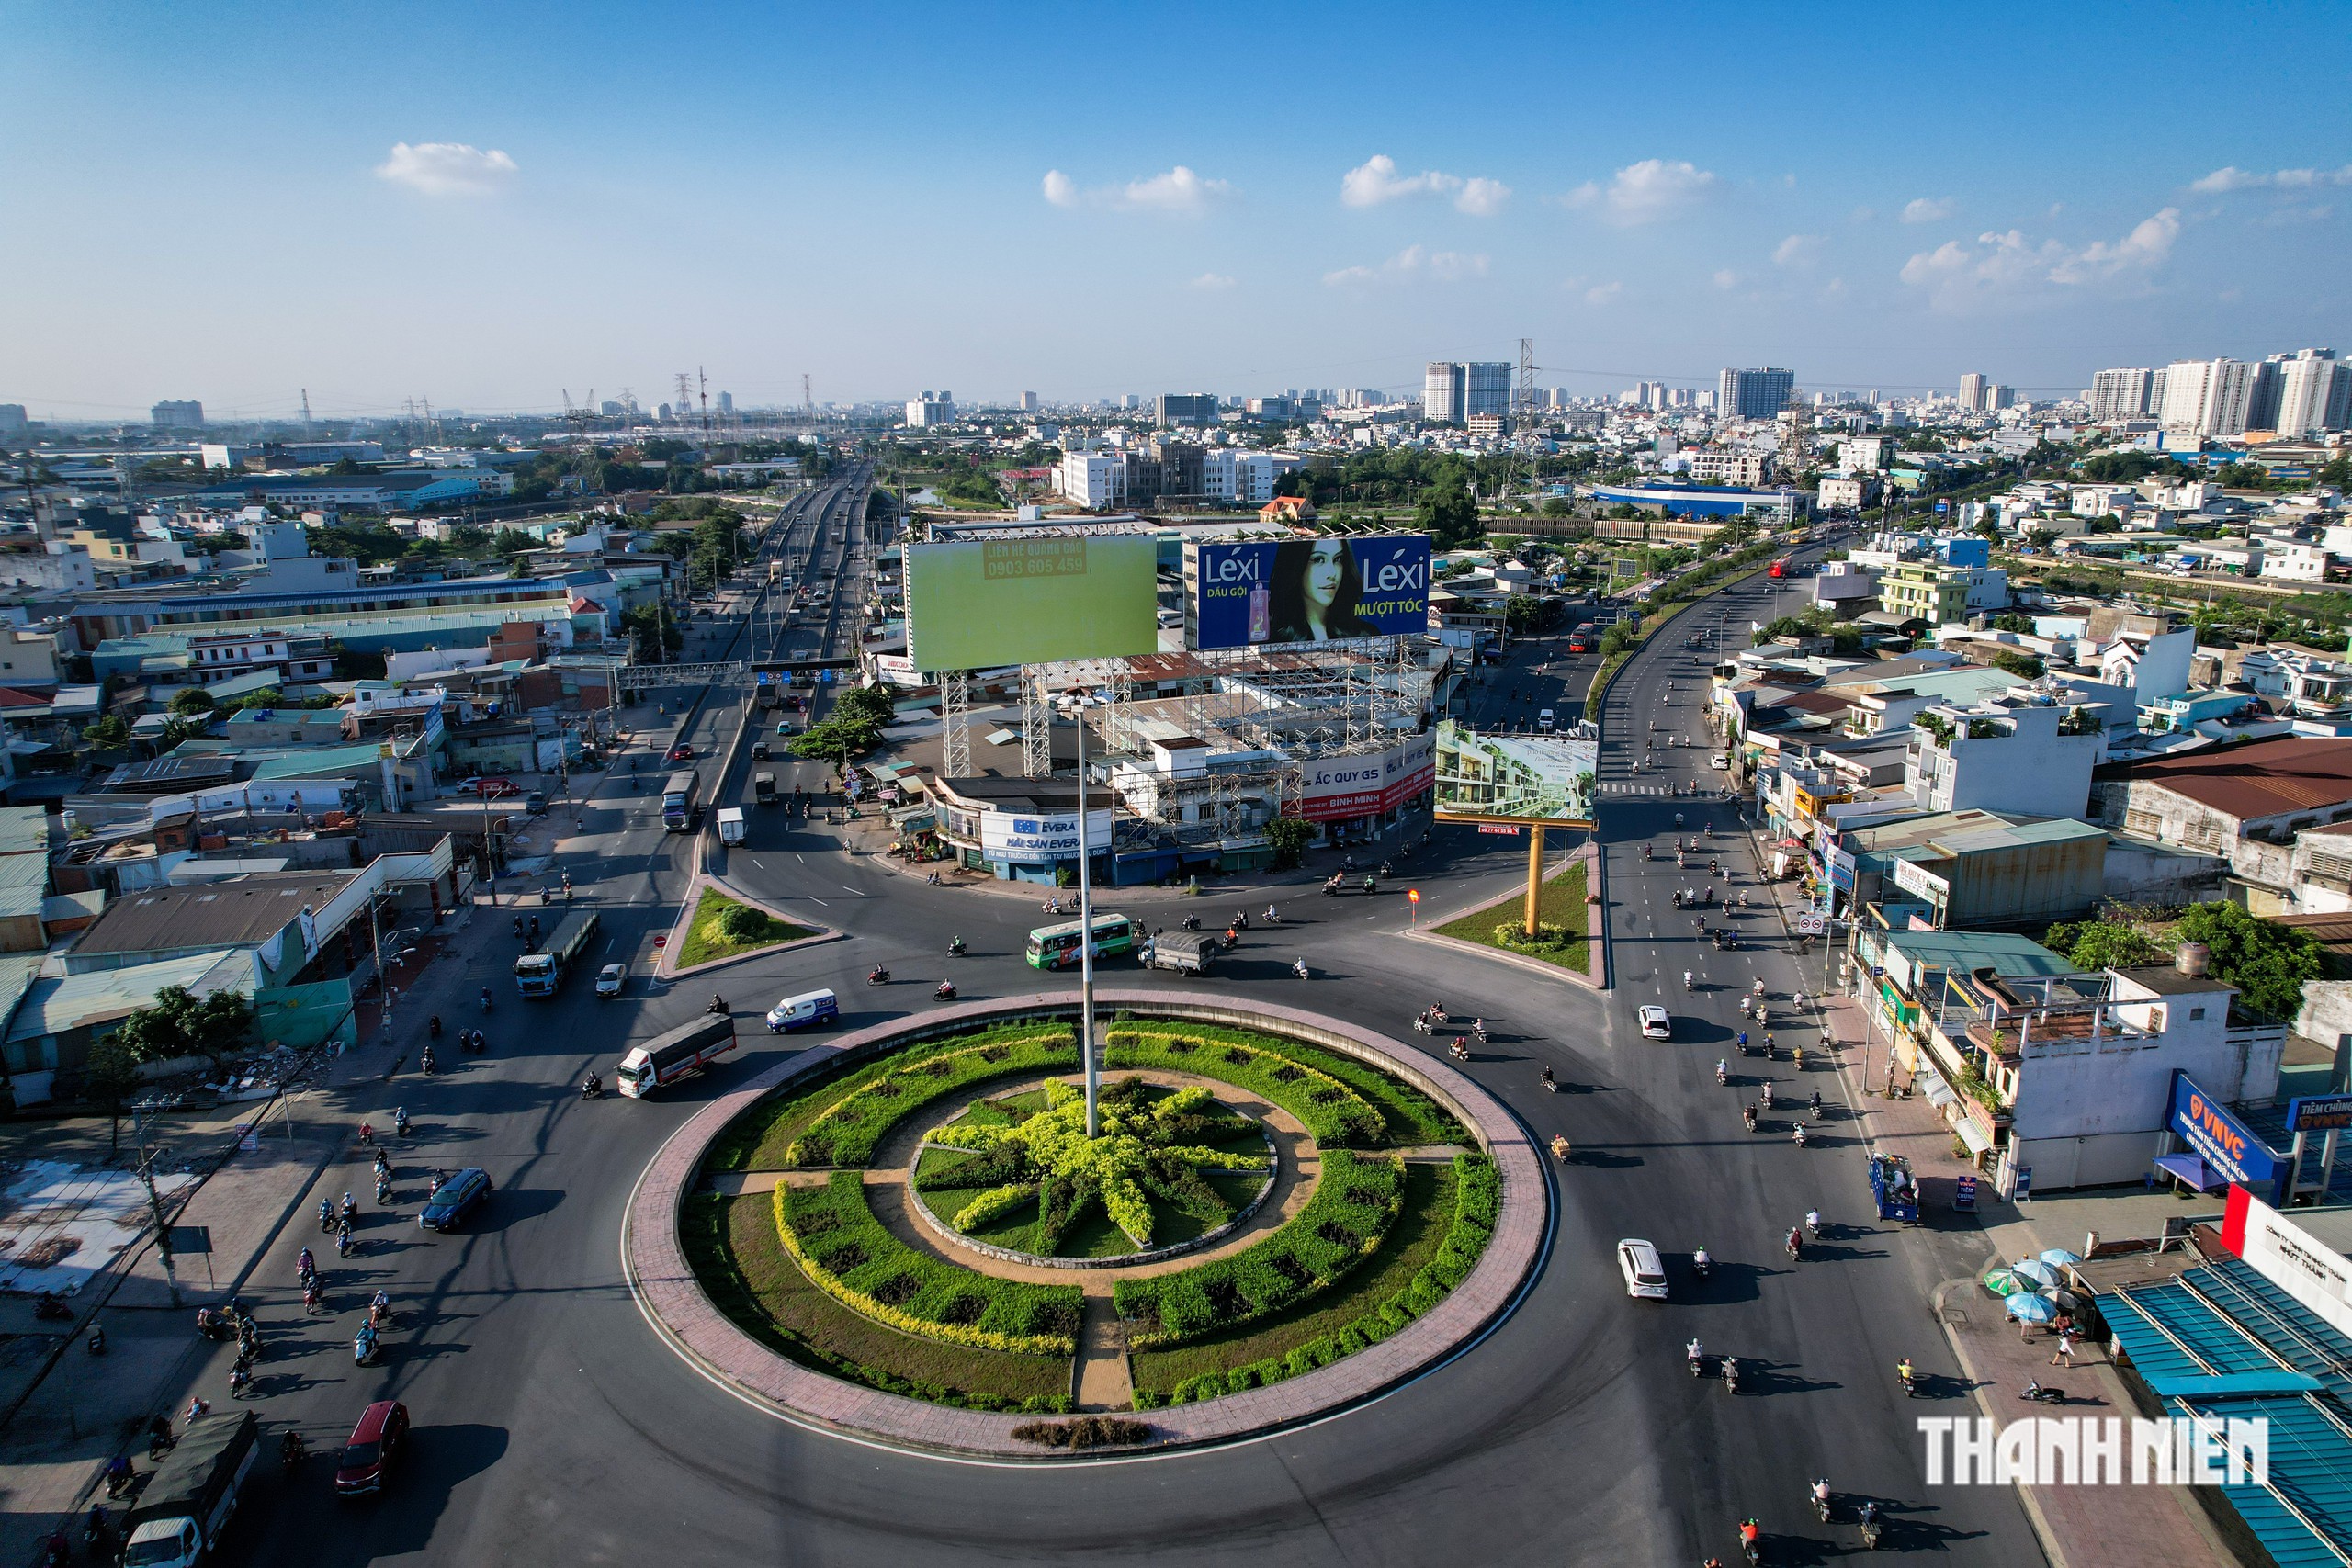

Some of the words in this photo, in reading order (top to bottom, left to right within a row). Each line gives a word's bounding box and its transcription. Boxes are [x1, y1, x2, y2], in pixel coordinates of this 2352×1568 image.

[988, 543, 1009, 558] LIÊN
[1012, 544, 1024, 558] HỆ
[1027, 540, 1060, 557] QUẢNG
[1063, 541, 1082, 554] CÁO
[988, 560, 1023, 576] 0903
[1027, 558, 1053, 574] 605
[1057, 558, 1083, 572] 459
[1230, 585, 1248, 598] GỘI
[1354, 600, 1396, 617] MƯỢT
[1397, 597, 1423, 613] TÓC
[1314, 771, 1331, 786] ẮC
[1334, 772, 1360, 783] QUY
[1362, 770, 1379, 780] GS
[1329, 795, 1353, 807] BÌNH
[1354, 795, 1380, 805] MINH
[1042, 822, 1076, 833] EVERA
[1026, 837, 1048, 849] SẢN
[1041, 852, 1052, 861] TẬN
[2301, 1101, 2324, 1114] TIÊM
[2204, 1106, 2245, 1160] VNVC
[2301, 1258, 2326, 1281] THÀNH
